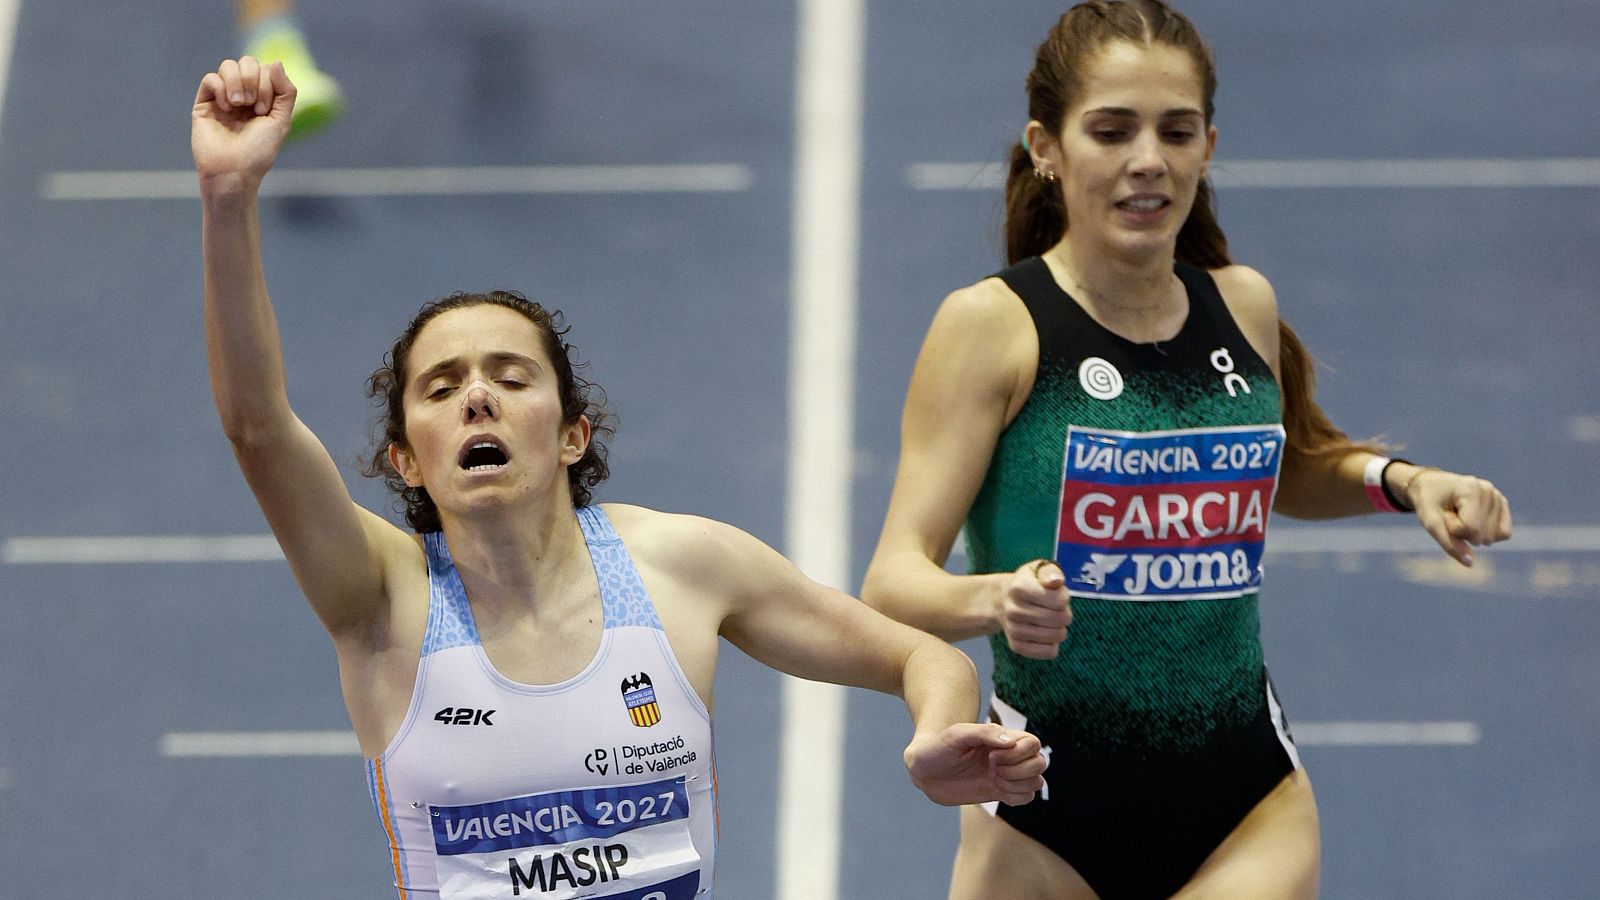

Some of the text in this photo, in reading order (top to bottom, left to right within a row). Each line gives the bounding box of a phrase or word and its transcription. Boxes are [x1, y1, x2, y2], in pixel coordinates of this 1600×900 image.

[1074, 440, 1278, 475] VALENCIA 2027
[1073, 490, 1264, 541] GARCIA
[434, 707, 496, 726] 42K
[622, 735, 685, 760] Diputació
[625, 751, 697, 775] de València
[444, 791, 675, 842] VALENCIA 2027
[508, 843, 628, 896] MASIP
